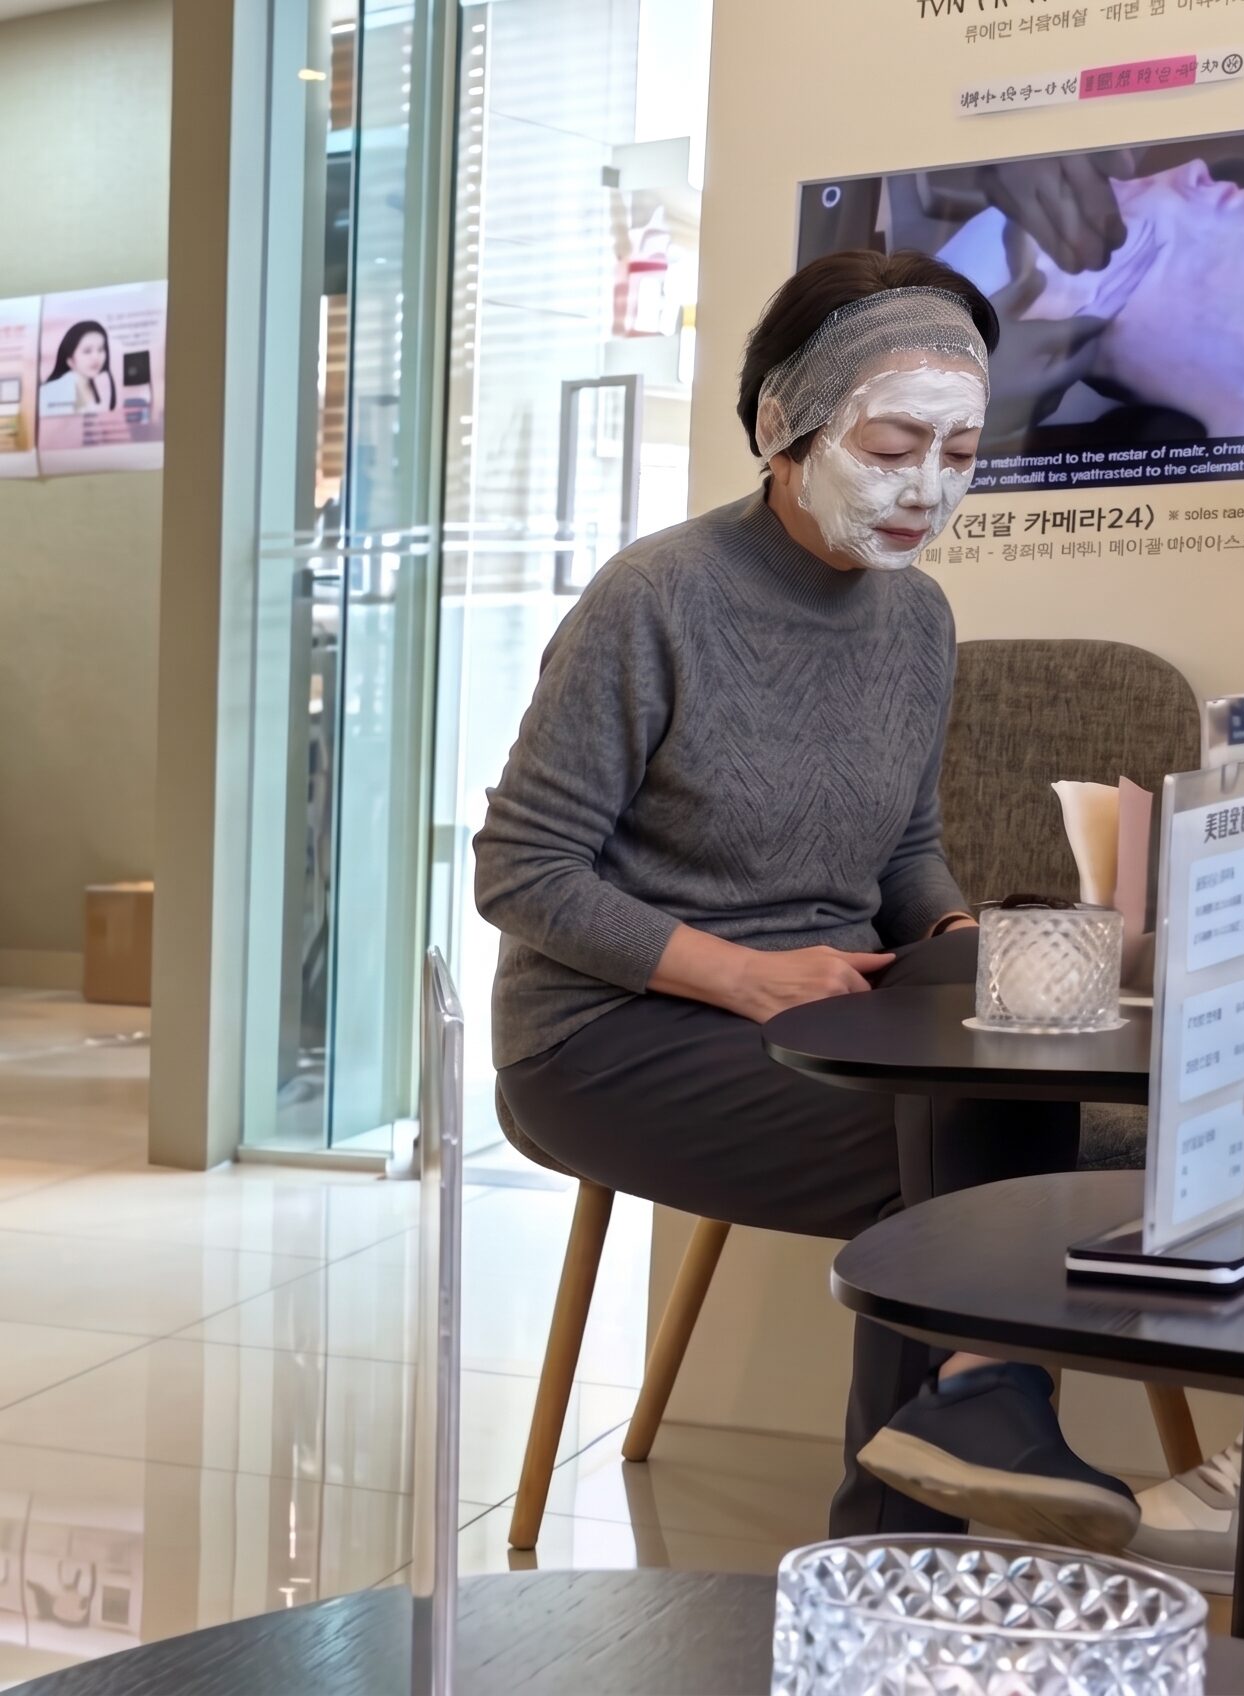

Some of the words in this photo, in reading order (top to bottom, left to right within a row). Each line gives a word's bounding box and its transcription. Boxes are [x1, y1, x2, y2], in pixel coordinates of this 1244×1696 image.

[1065, 453, 1078, 465] to
[1082, 451, 1105, 463] the
[1151, 446, 1166, 459] of
[1146, 466, 1161, 477] to
[1164, 463, 1186, 475] the
